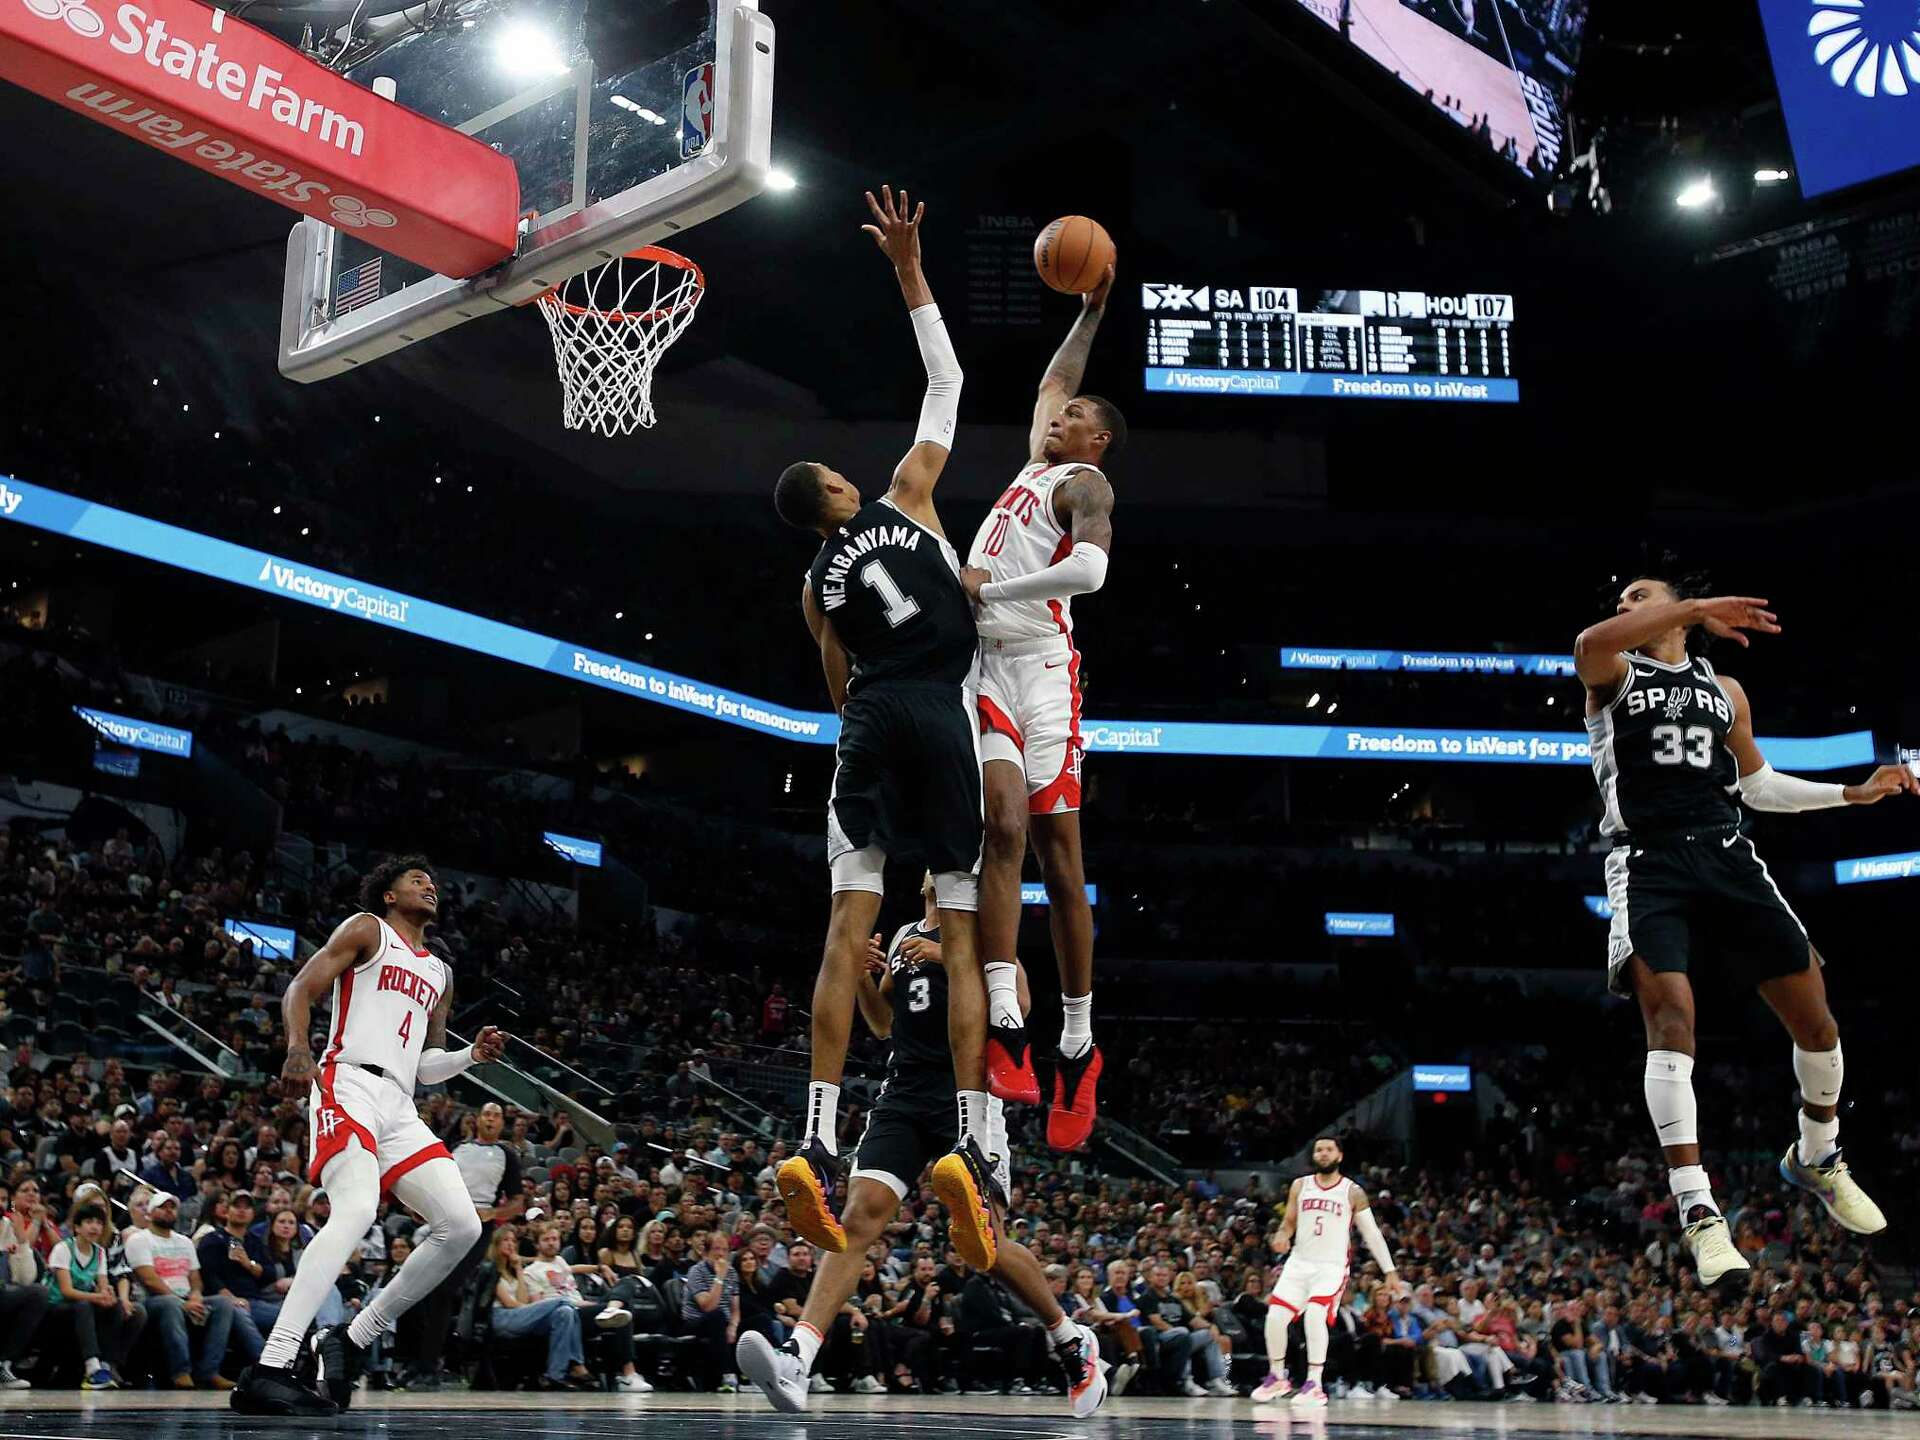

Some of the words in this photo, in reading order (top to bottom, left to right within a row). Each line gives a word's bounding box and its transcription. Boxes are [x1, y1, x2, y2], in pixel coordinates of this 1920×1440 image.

[110, 3, 365, 157] StateFarm
[1214, 289, 1245, 309] SA
[1256, 290, 1289, 311] 104
[1426, 296, 1467, 316] HOU
[1476, 297, 1507, 318] 107
[1333, 379, 1410, 395] Freedom
[1413, 382, 1432, 397] to
[983, 512, 1011, 557] 10
[823, 525, 921, 612] WEMBANYAMA
[860, 558, 922, 630] 1
[573, 652, 647, 690] Freedom
[648, 677, 667, 695] to
[668, 681, 716, 709] inVest
[715, 695, 740, 715] for
[740, 703, 820, 735] tomorrow
[1347, 732, 1437, 753] Freedom
[1440, 736, 1462, 753] to
[1465, 735, 1527, 756] inVest
[1528, 737, 1560, 760] for
[1652, 724, 1713, 769] 33
[907, 977, 931, 1013] 3
[398, 1010, 414, 1049] 4
[1313, 1215, 1324, 1236] 5
